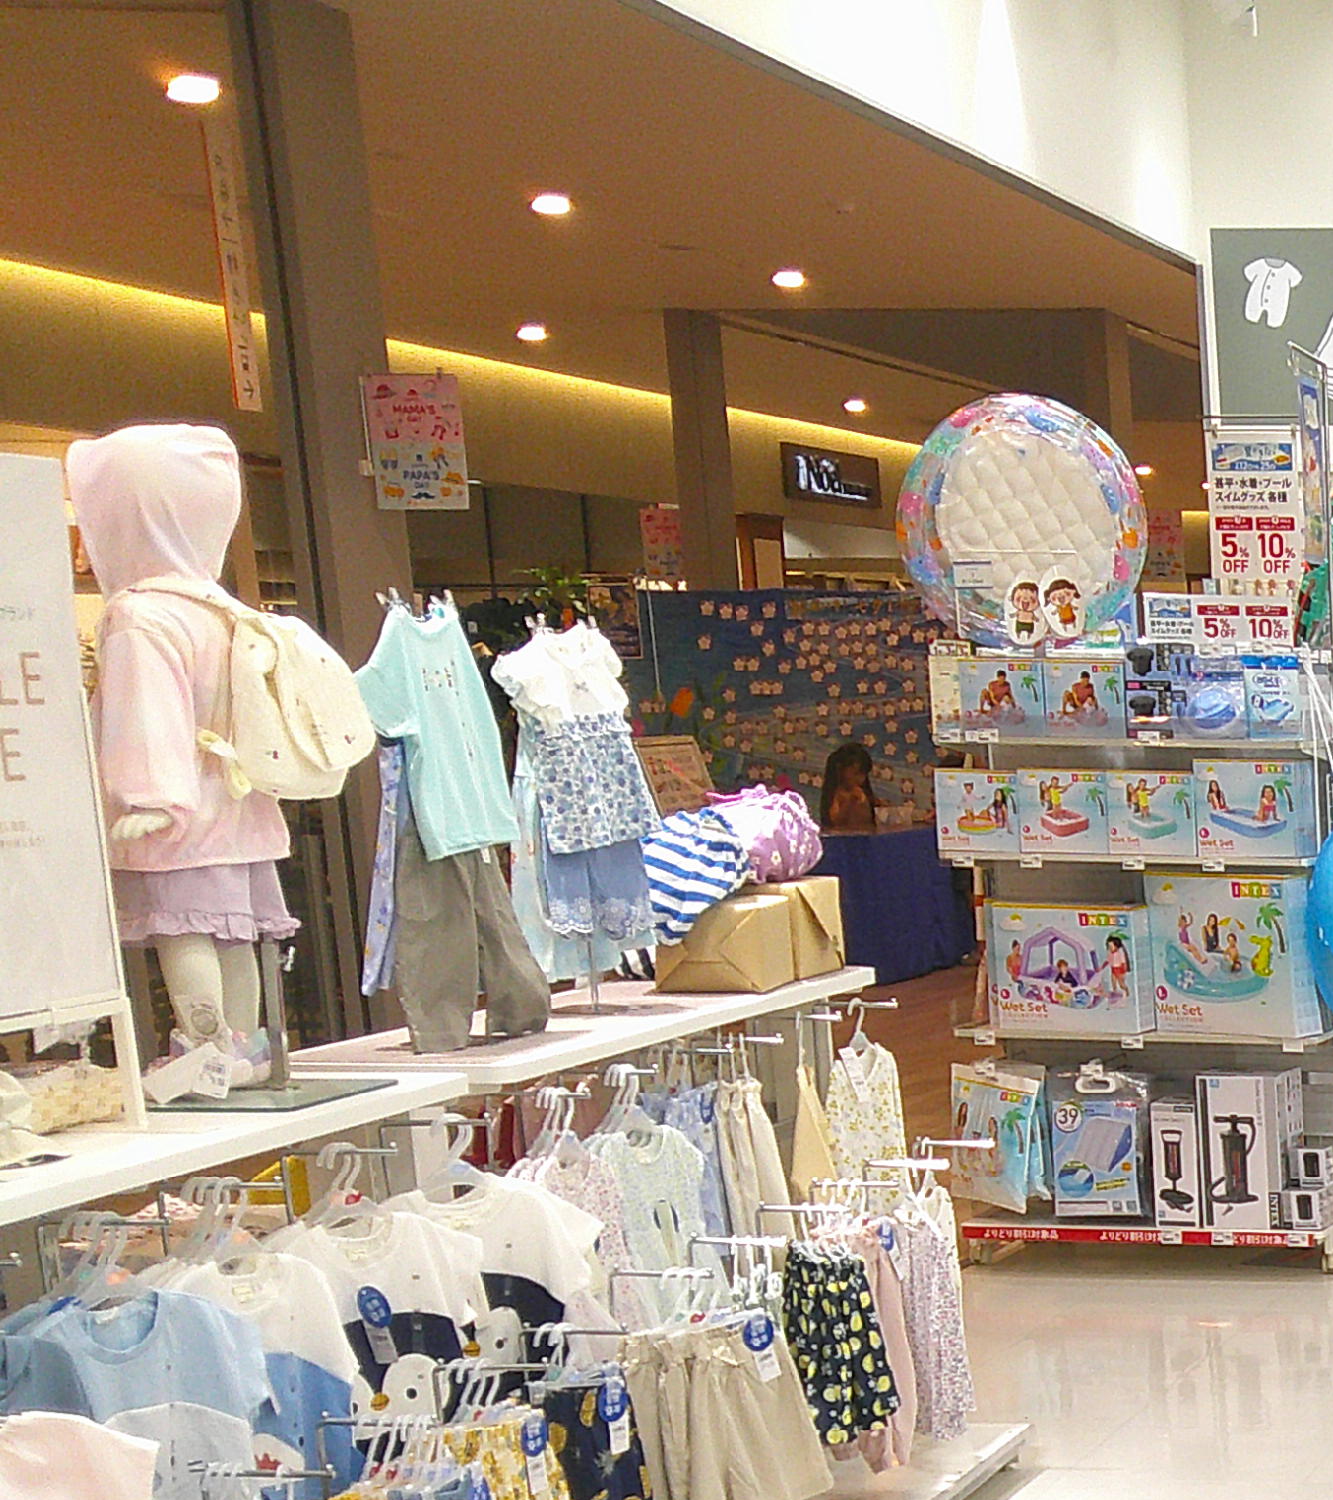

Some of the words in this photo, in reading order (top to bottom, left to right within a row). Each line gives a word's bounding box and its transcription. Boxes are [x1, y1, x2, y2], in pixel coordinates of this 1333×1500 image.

[1215, 491, 1266, 502] スイムグッズ
[1221, 533, 1249, 559] 5%
[1257, 533, 1297, 559] 10%
[1223, 559, 1249, 573] OFF
[1263, 560, 1291, 574] OFF
[1204, 618, 1231, 639] 5%
[1220, 629, 1237, 639] OFF
[1249, 618, 1284, 639] 10%
[1273, 629, 1290, 640] OFF
[1199, 838, 1219, 848] Wet
[1232, 882, 1281, 899] INTEX
[1080, 912, 1128, 928] INTEX
[1001, 1002, 1025, 1013] Wet
[1029, 1002, 1048, 1014] Set
[1160, 1004, 1183, 1015] Wet
[1186, 1005, 1203, 1017] Set
[1058, 1108, 1079, 1125] 39
[983, 1228, 1059, 1241] よりどり割引対象品
